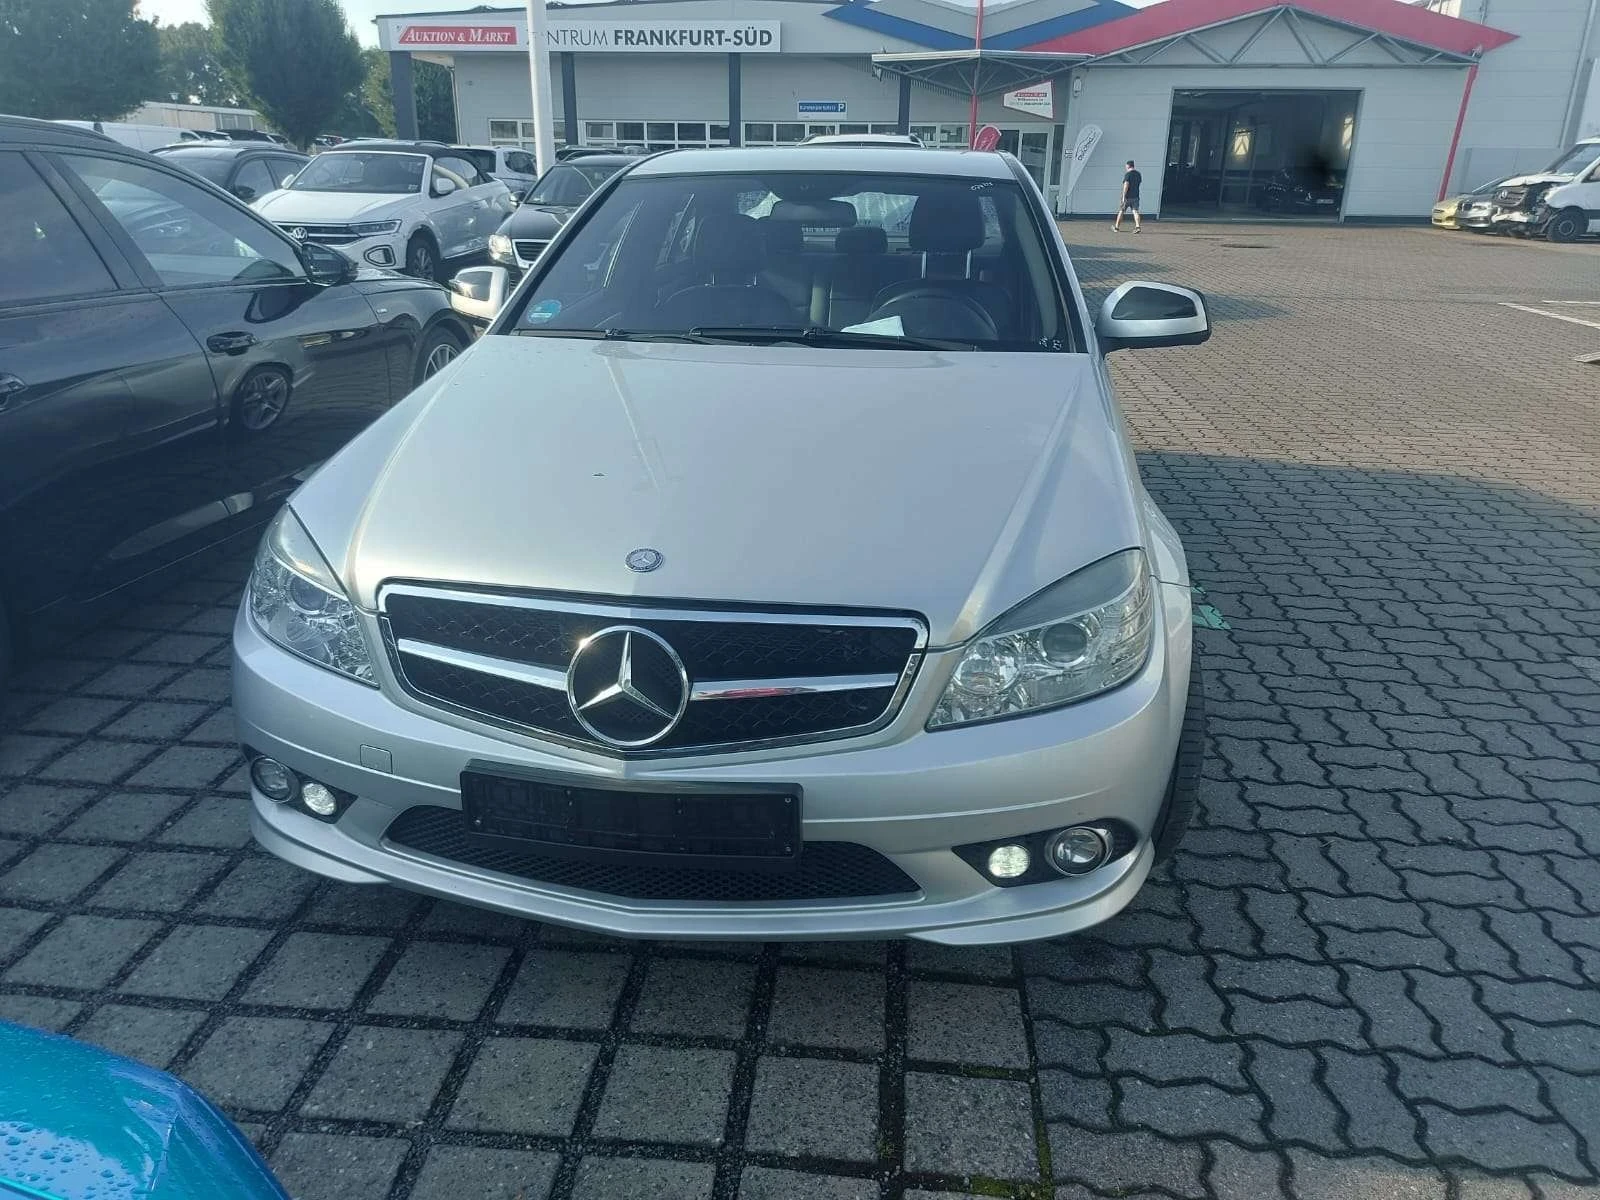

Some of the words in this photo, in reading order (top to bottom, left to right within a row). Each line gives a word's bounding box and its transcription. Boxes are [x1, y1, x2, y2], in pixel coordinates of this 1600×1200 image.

[405, 29, 456, 42] AUKTION
[457, 32, 465, 42] &
[468, 28, 511, 42] MARKT
[525, 29, 608, 46] NTRUM
[614, 26, 773, 46] FRANKFURT-SÜD
